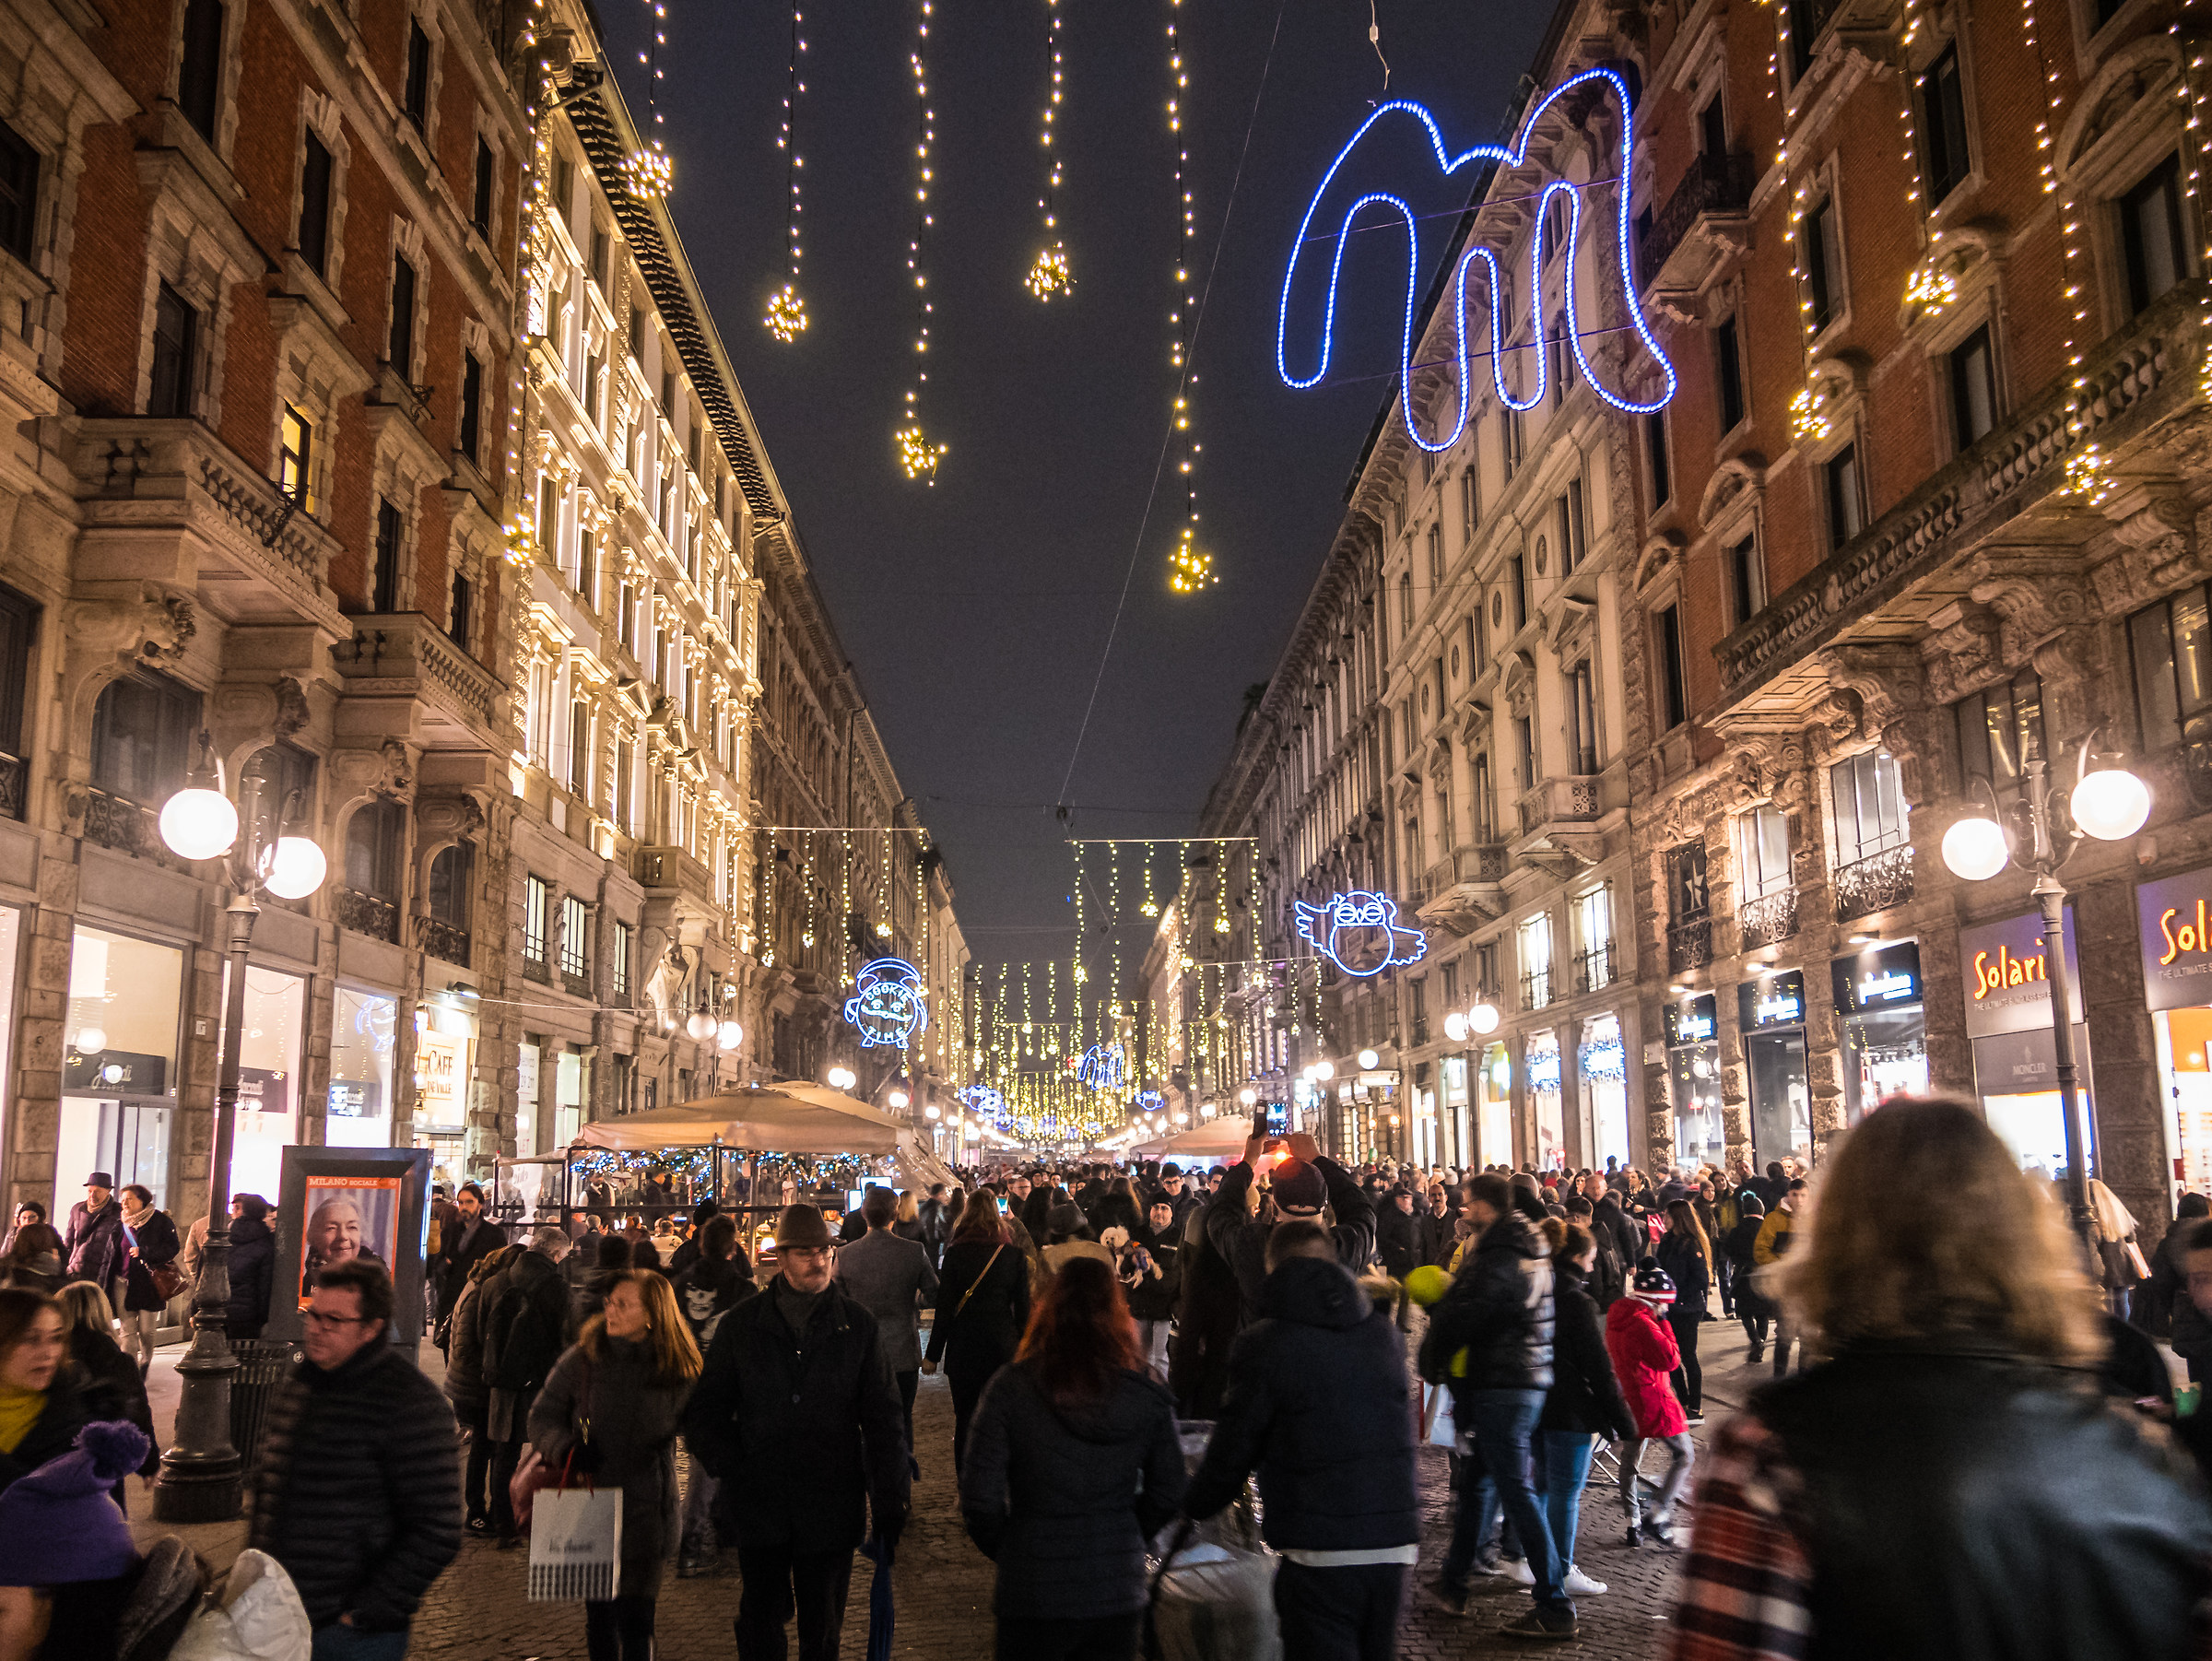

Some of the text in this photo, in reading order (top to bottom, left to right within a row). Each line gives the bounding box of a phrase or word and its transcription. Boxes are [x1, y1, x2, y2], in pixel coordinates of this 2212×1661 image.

[2159, 898, 2212, 966] Sol
[1973, 937, 2046, 1000] Solari
[2158, 970, 2172, 980] THE
[865, 984, 909, 1003] COOKIE
[868, 1025, 906, 1042] TIME
[2013, 1062, 2047, 1076] MONCLER
[309, 1178, 347, 1186] MILANO
